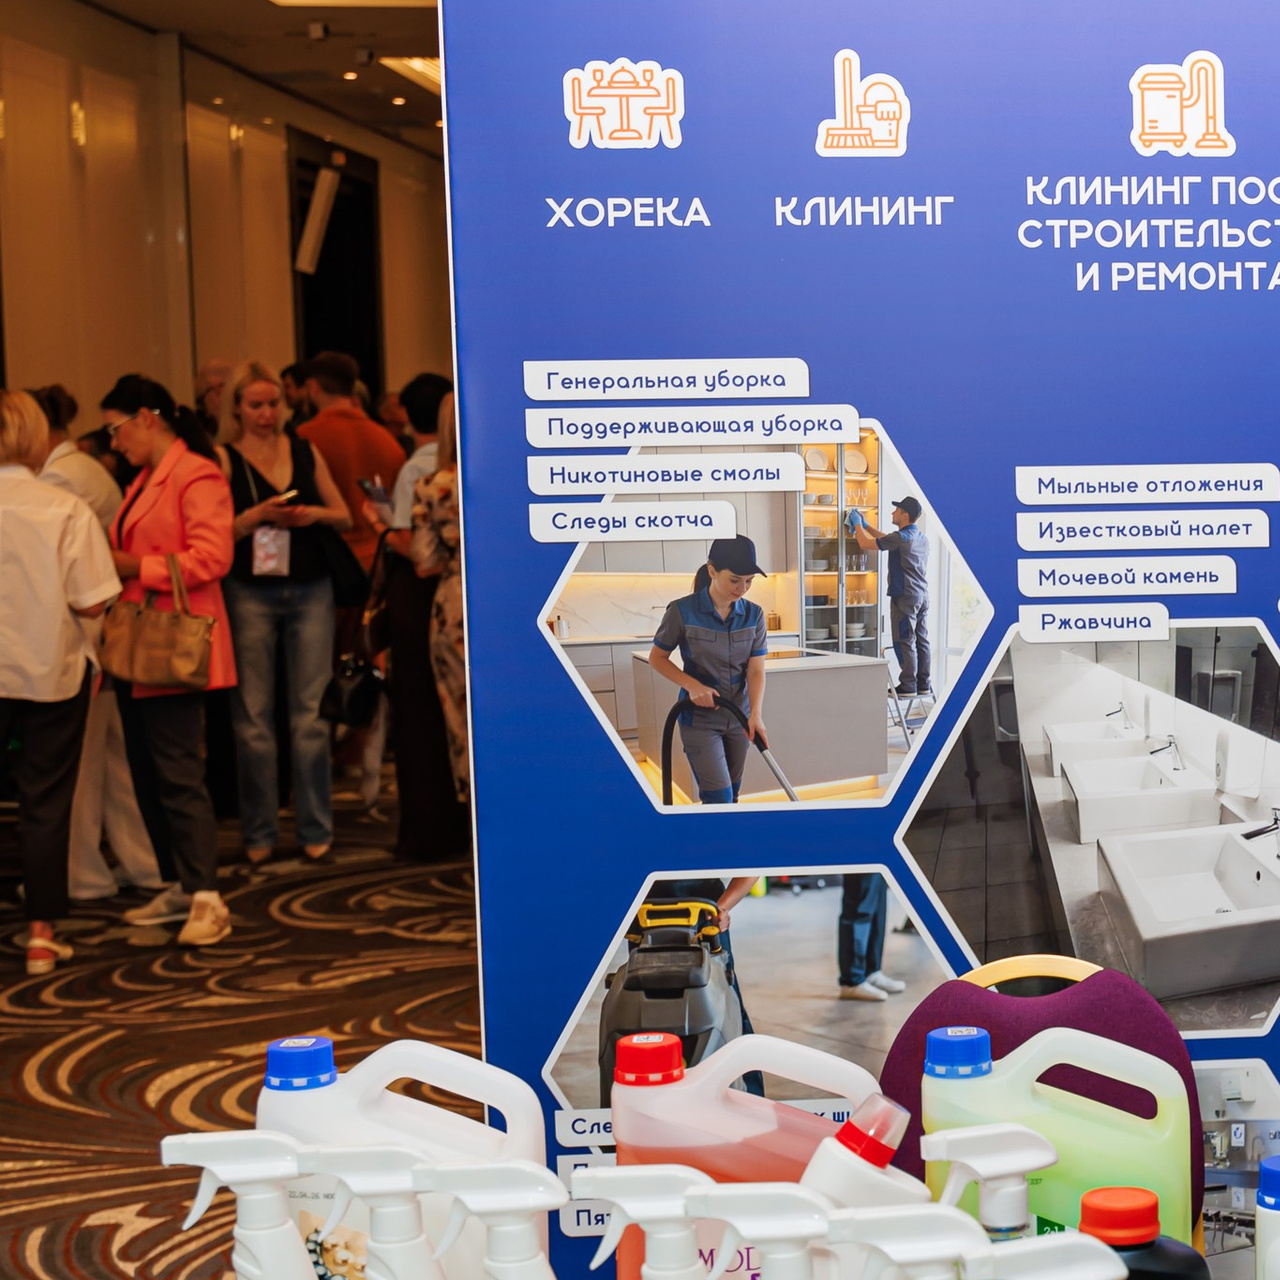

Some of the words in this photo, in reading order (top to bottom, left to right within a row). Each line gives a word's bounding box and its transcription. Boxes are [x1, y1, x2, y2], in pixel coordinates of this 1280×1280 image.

[1025, 176, 1202, 207] КЛИНИНГ
[545, 197, 711, 228] ХОРЕКА
[774, 196, 955, 227] КЛИНИНГ
[1075, 262, 1101, 292] И
[546, 370, 697, 394] Генеральная
[704, 369, 787, 393] уборка
[547, 416, 755, 439] Поддерживающая
[761, 414, 844, 438] уборка
[549, 464, 703, 485] Никотиновые
[710, 465, 781, 483] смолы
[1037, 477, 1139, 495] Мыльные
[1146, 475, 1264, 494] отложения
[551, 511, 627, 533] Следы
[634, 511, 714, 529] скотча
[1038, 518, 1182, 543] Известковый
[1188, 519, 1253, 537] налет
[1038, 567, 1136, 587] Мочевой
[1142, 568, 1220, 585] камень
[1041, 613, 1152, 633] Ржавчина
